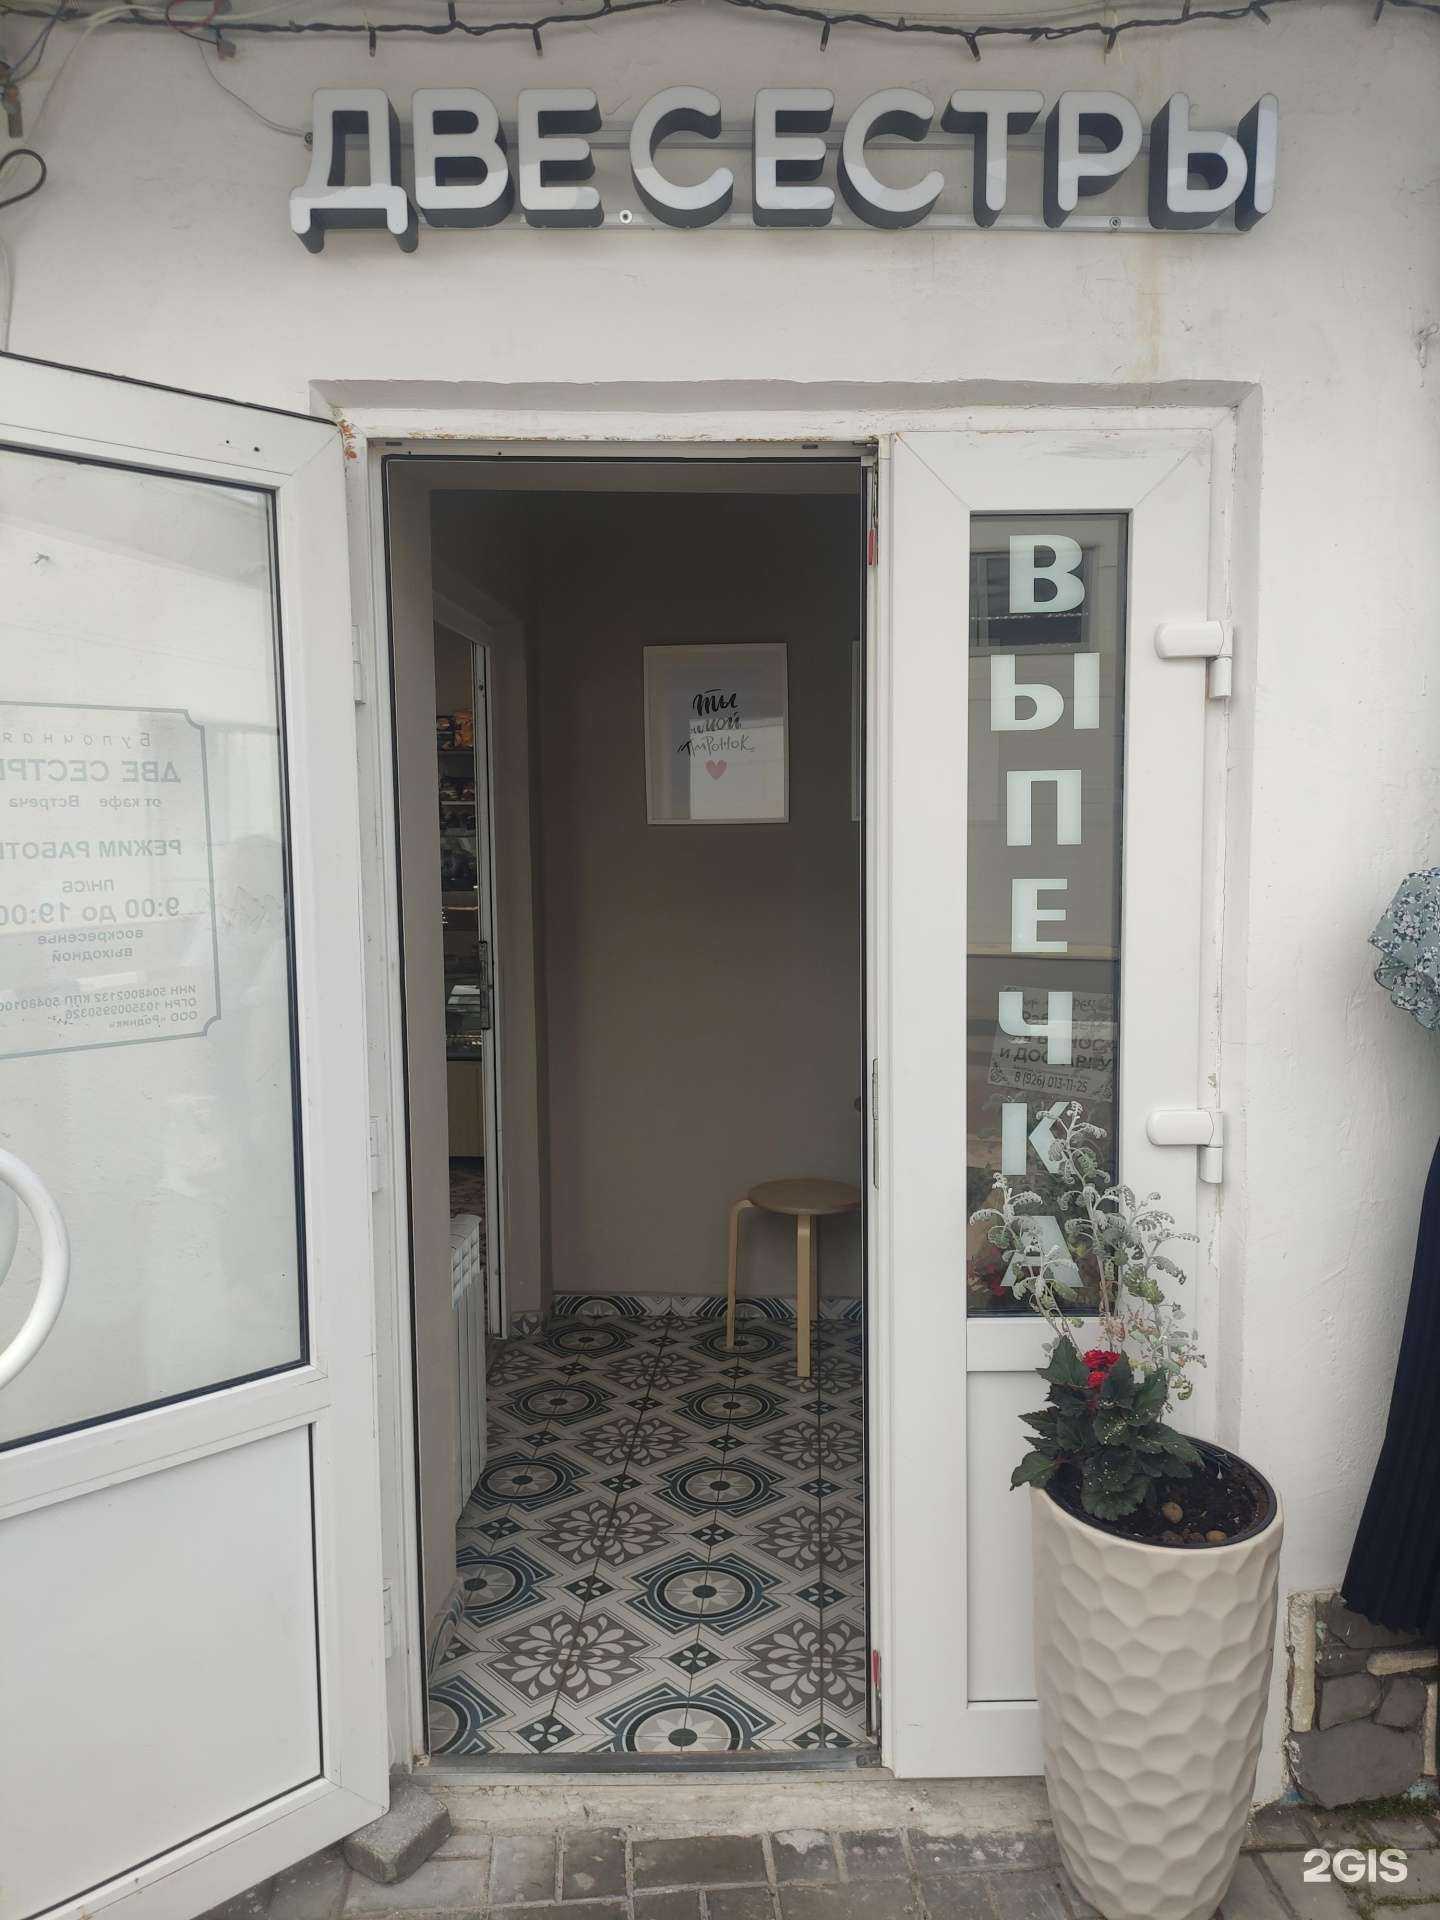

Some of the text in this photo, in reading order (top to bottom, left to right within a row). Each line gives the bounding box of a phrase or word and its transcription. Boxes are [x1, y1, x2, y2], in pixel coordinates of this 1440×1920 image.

[290, 84, 1278, 248] ДВЕ СЕСТРЫ
[990, 533, 1101, 1288] ВЫПЕЧКА
